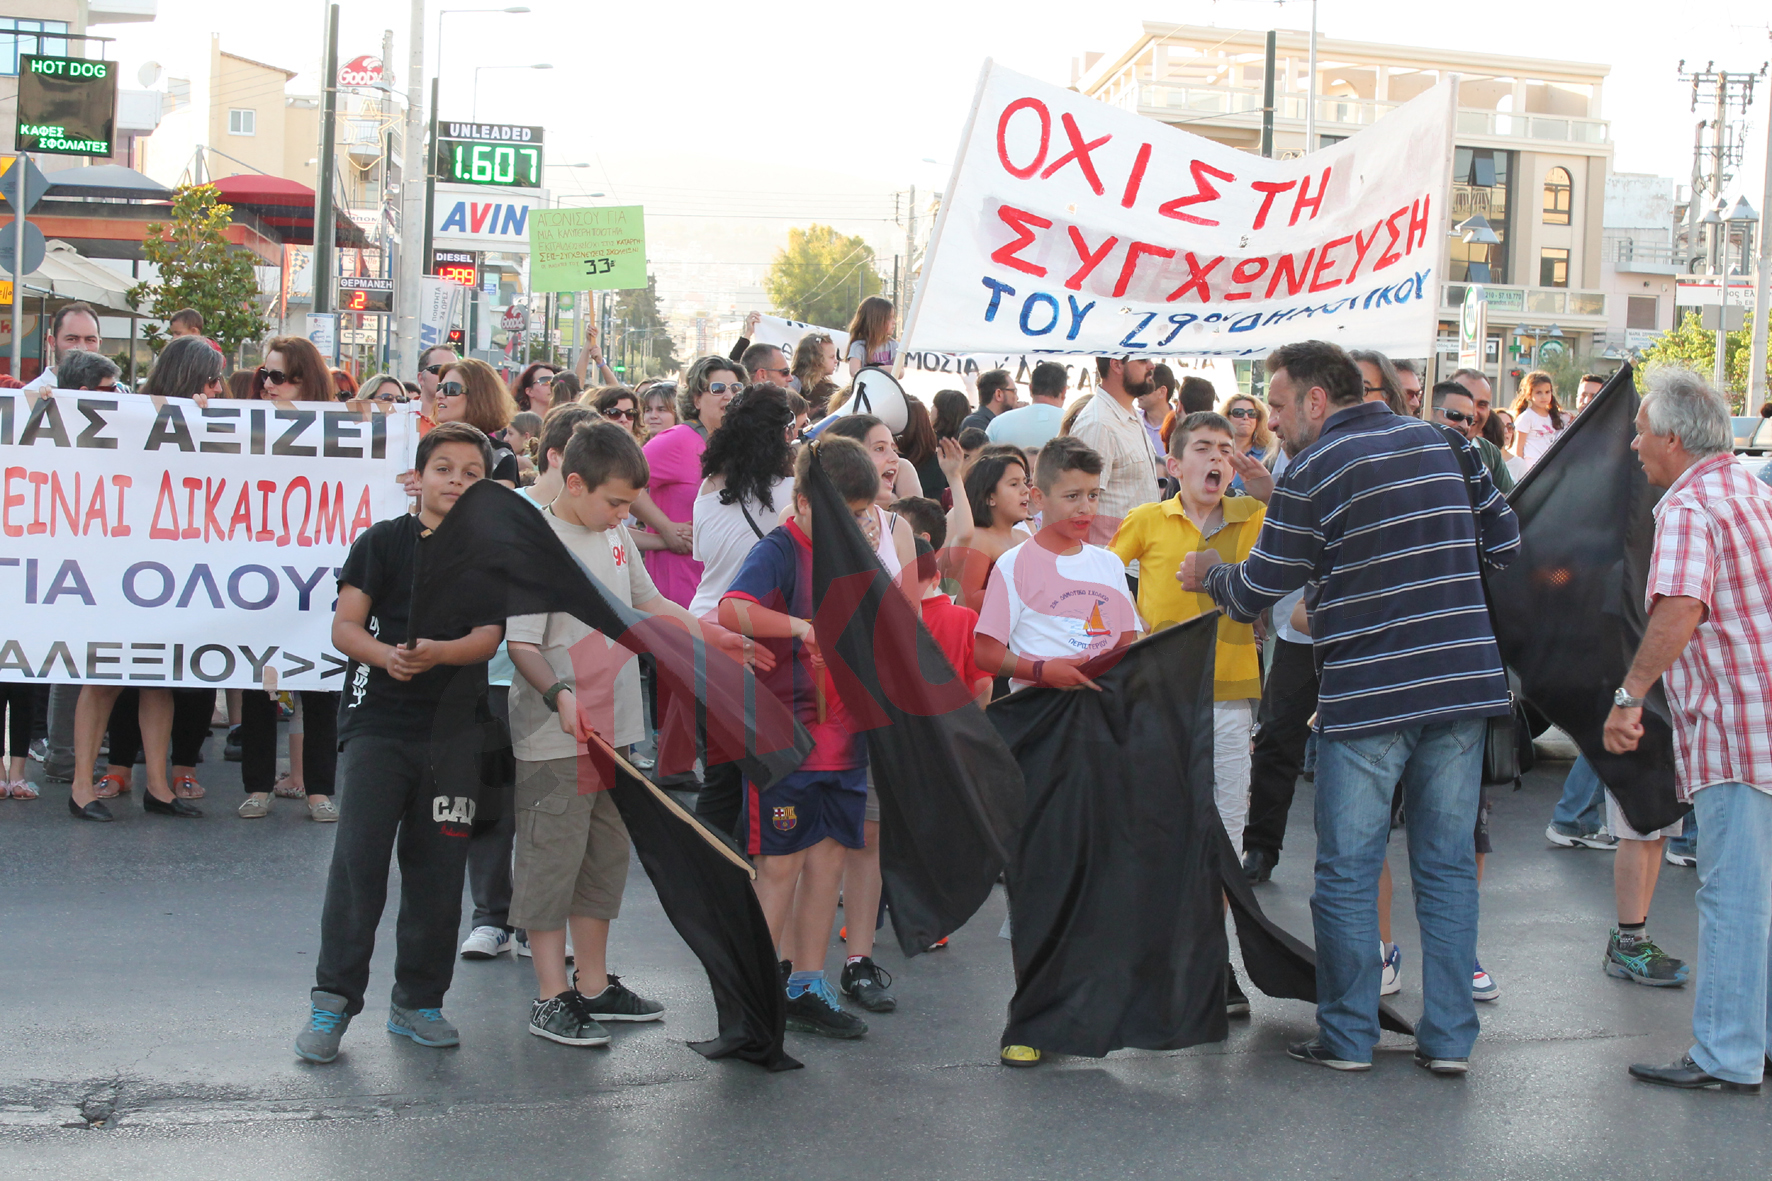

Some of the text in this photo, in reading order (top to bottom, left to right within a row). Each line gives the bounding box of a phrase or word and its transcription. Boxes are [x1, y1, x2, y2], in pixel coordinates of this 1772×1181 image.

[31, 60, 106, 78] HOT DOG
[20, 124, 64, 138] ΚΑΦΕΣ
[449, 123, 532, 141] UNLEADED
[39, 138, 107, 153] ΣΦΟΛΙΑΤΕΣ
[455, 145, 538, 183] 1.607
[996, 96, 1332, 230] ΟΧΙ ΣΤΗ
[440, 201, 529, 236] AVIN
[607, 210, 627, 225] ΓΙΑ
[436, 253, 474, 262] DIESEL
[990, 194, 1431, 304] ΣΥΓΧΩΝΕΥΣΗ
[340, 279, 393, 289] ΘΕΡΜΑΝΣΗ
[982, 276, 1096, 342] ΤΟΥ
[144, 404, 387, 460] ΑΞΙΖΕΙ
[3, 466, 374, 548] ΕΙΝΑΙ ΔΙΚΑΙΩΜΑ
